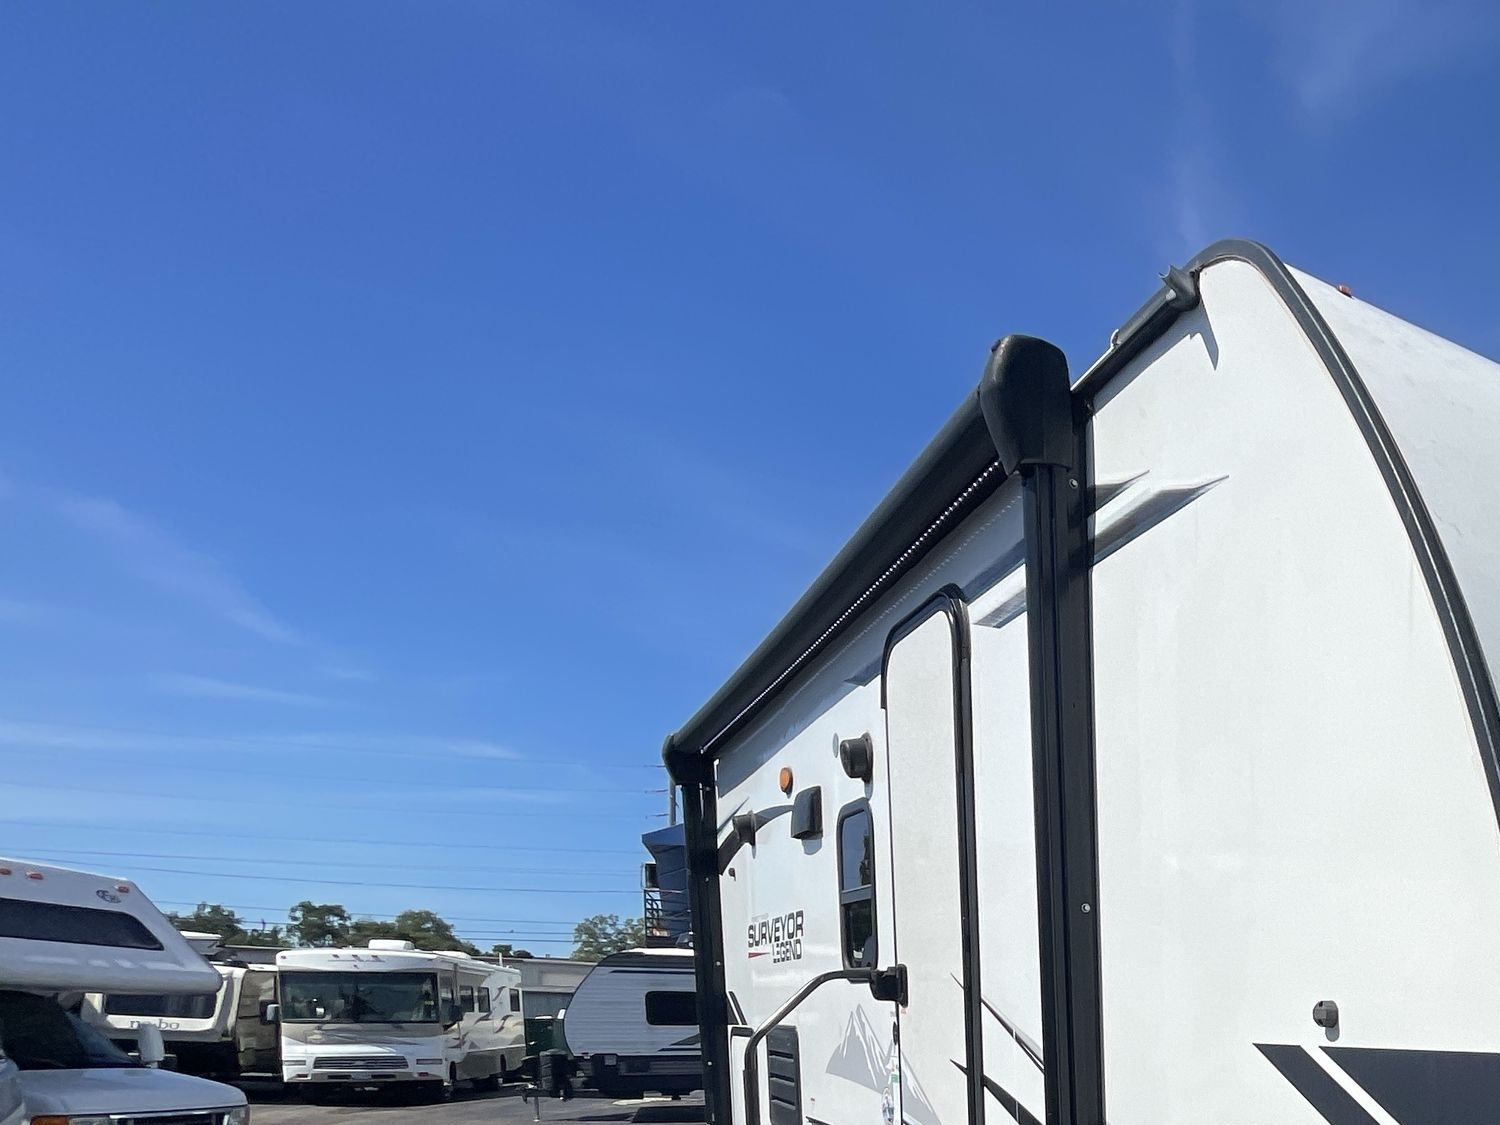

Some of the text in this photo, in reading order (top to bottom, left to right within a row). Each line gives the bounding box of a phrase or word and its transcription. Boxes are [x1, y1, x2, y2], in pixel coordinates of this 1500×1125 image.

[747, 909, 804, 948] SURVEYOR
[771, 938, 803, 964] LEGEND
[129, 1017, 181, 1030] nbo
